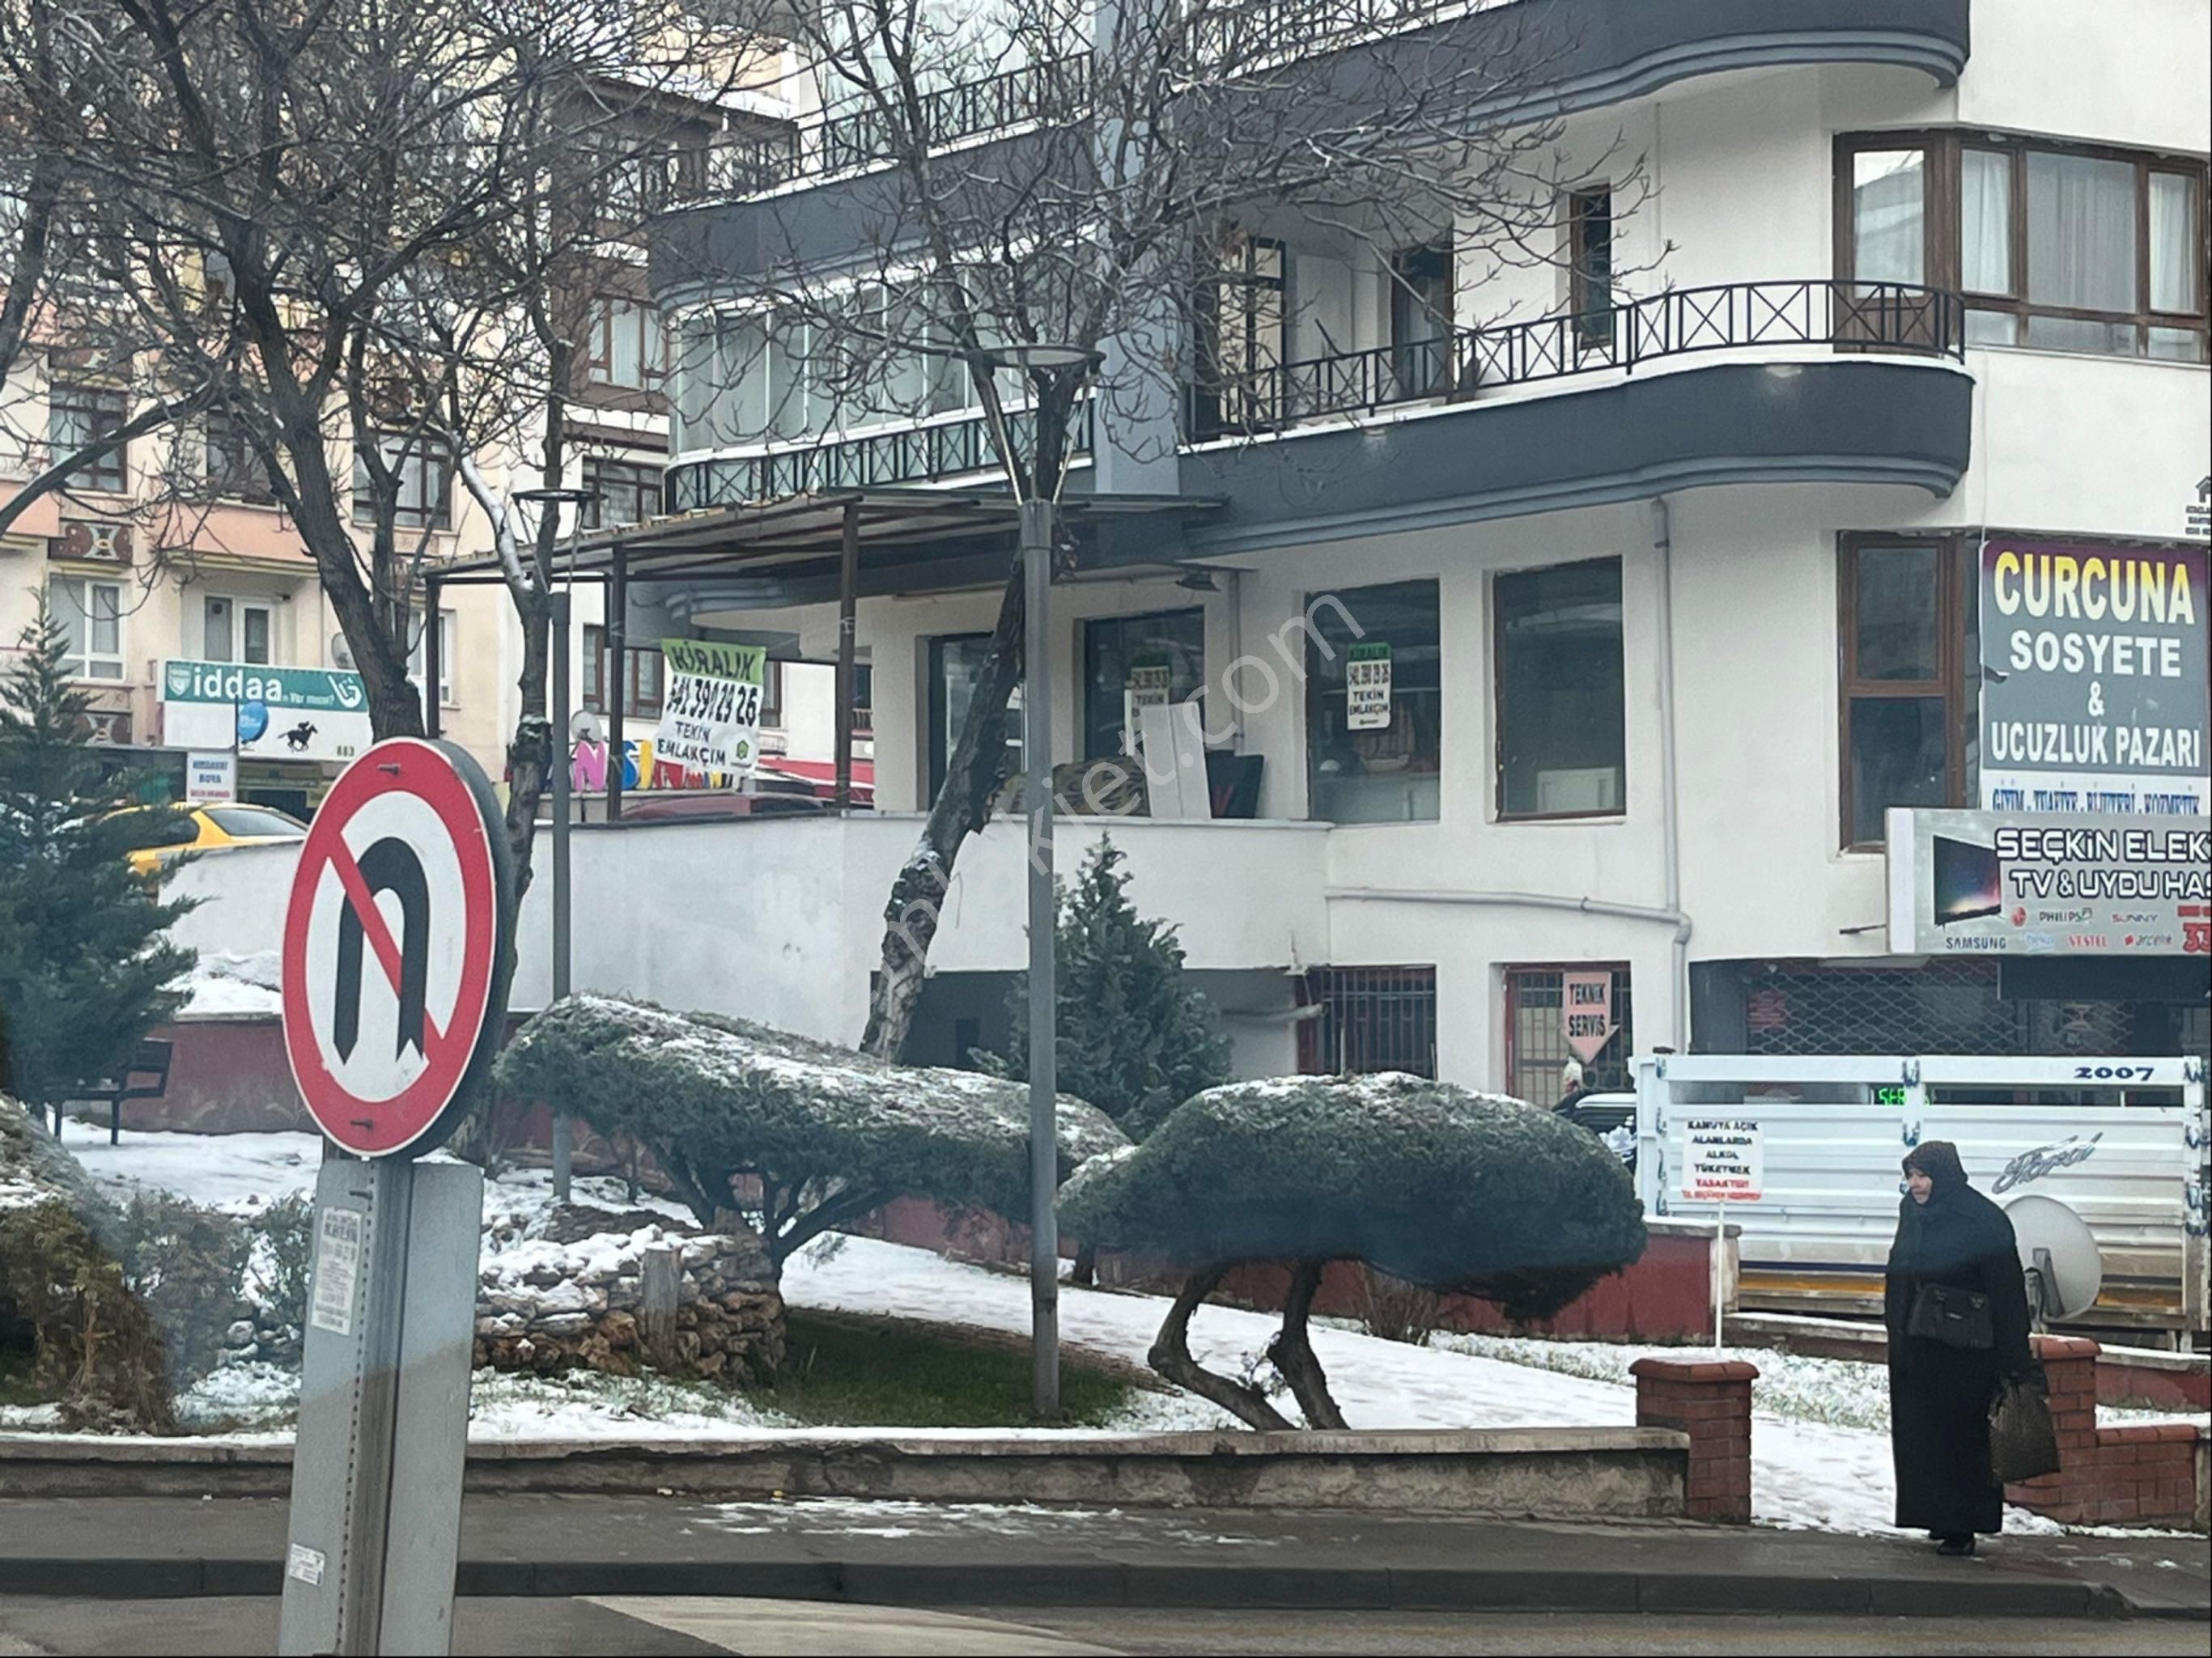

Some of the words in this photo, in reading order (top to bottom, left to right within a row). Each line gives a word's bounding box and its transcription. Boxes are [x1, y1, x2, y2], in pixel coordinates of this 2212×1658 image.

[1994, 551, 2195, 625] CURCUNA
[2010, 630, 2181, 677] SOSYETE
[193, 667, 282, 702] iddaa
[2087, 681, 2104, 717] &
[657, 738, 727, 767] EMLAKÇIM
[1991, 722, 2108, 765] UCUZLUK
[2116, 727, 2200, 767] PAZARI
[2125, 830, 2210, 863] ELEK
[2010, 871, 2053, 898] TV
[2058, 871, 2074, 898] &
[2078, 871, 2159, 899] UYDU
[1946, 937, 2006, 949] SAMSUNG
[2074, 1066, 2155, 1081] 2007
